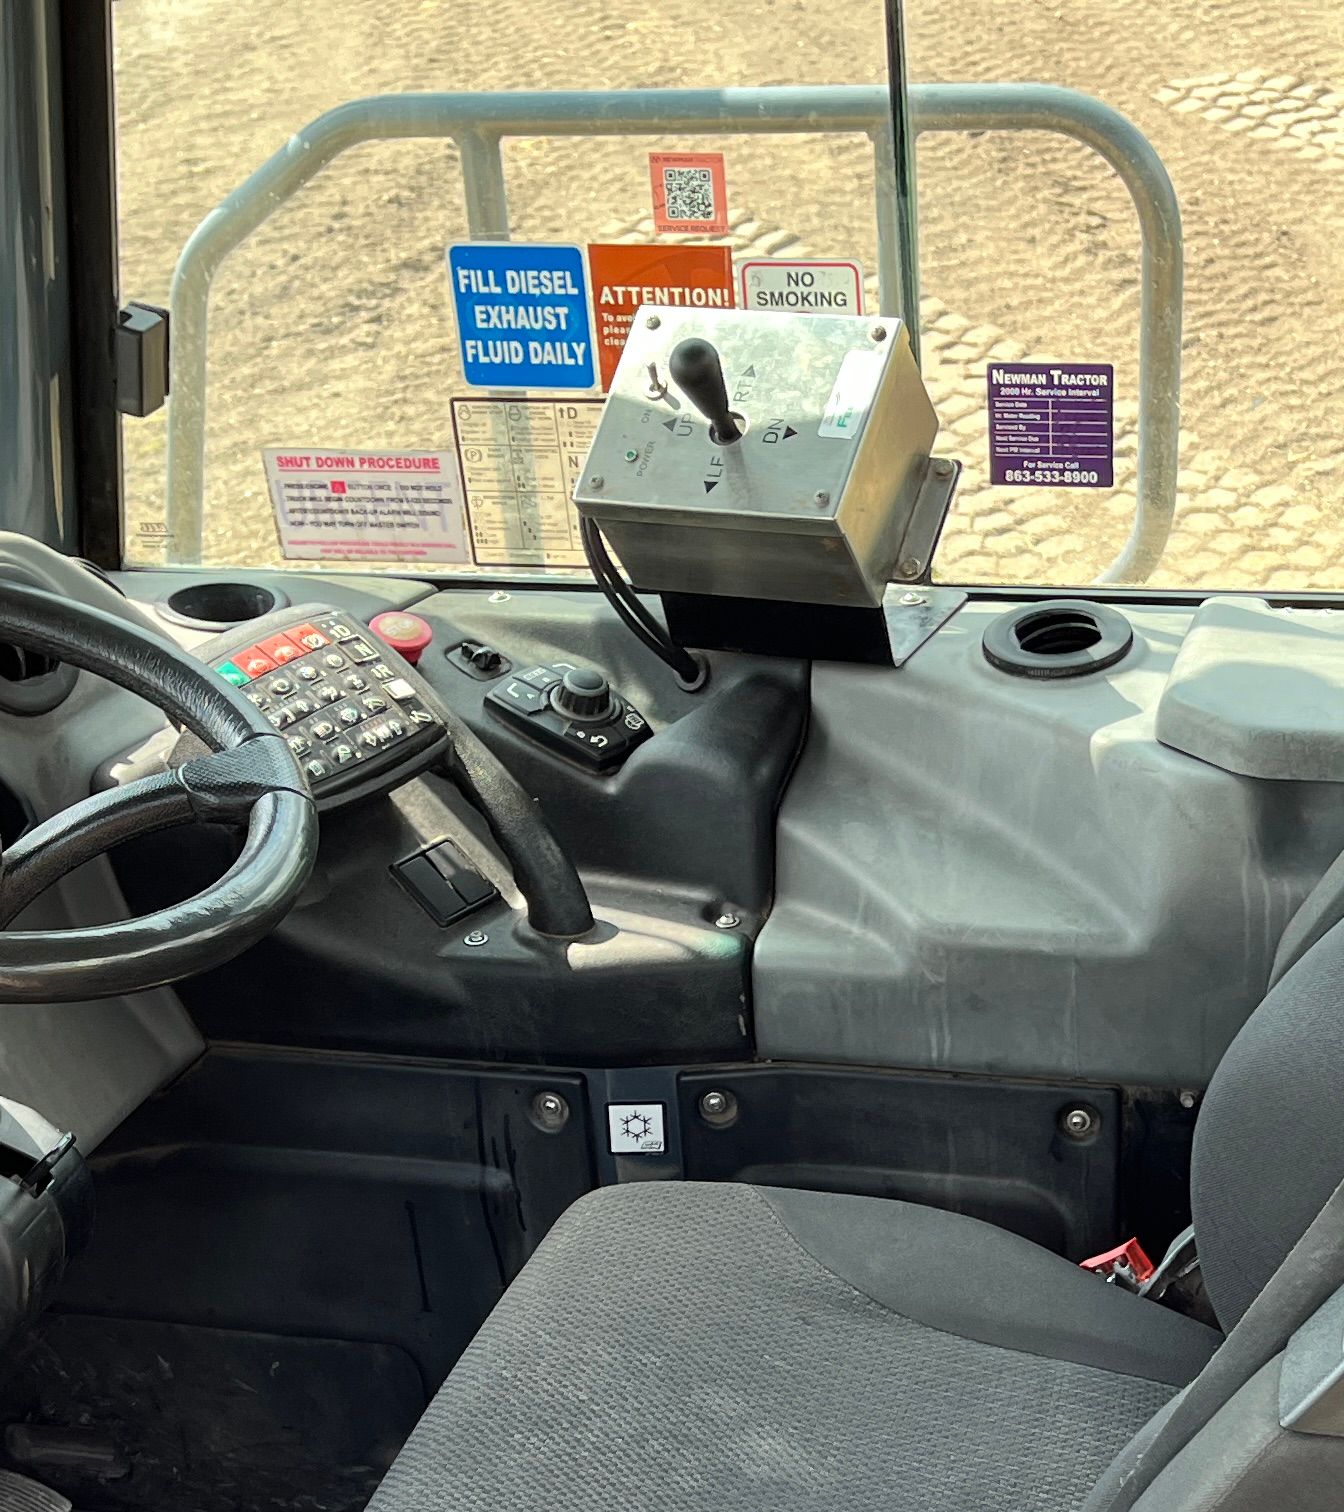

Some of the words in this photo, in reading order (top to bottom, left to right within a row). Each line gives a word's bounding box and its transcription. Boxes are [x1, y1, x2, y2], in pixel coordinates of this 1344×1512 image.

[457, 269, 502, 294] FILL
[506, 270, 579, 296] DIESEL
[786, 271, 814, 287] NO
[599, 286, 730, 307] ATTENTION!
[756, 291, 847, 307] SMOKING
[474, 305, 569, 330] EXHAUST
[601, 312, 614, 322] To
[465, 340, 524, 365] FLUID
[528, 341, 586, 366] DAILY
[733, 380, 752, 402] RT
[1035, 388, 1067, 396] Service
[1068, 388, 1100, 397] Interval
[676, 413, 696, 436] UP
[762, 418, 784, 444] DN
[276, 456, 312, 468] SHUT
[316, 457, 355, 469] DOWN
[359, 457, 440, 470] PROCEDURE
[636, 441, 656, 477] POWER
[706, 456, 724, 478] LF
[1037, 461, 1063, 469] Service
[1005, 470, 1098, 484] 863-533-8900
